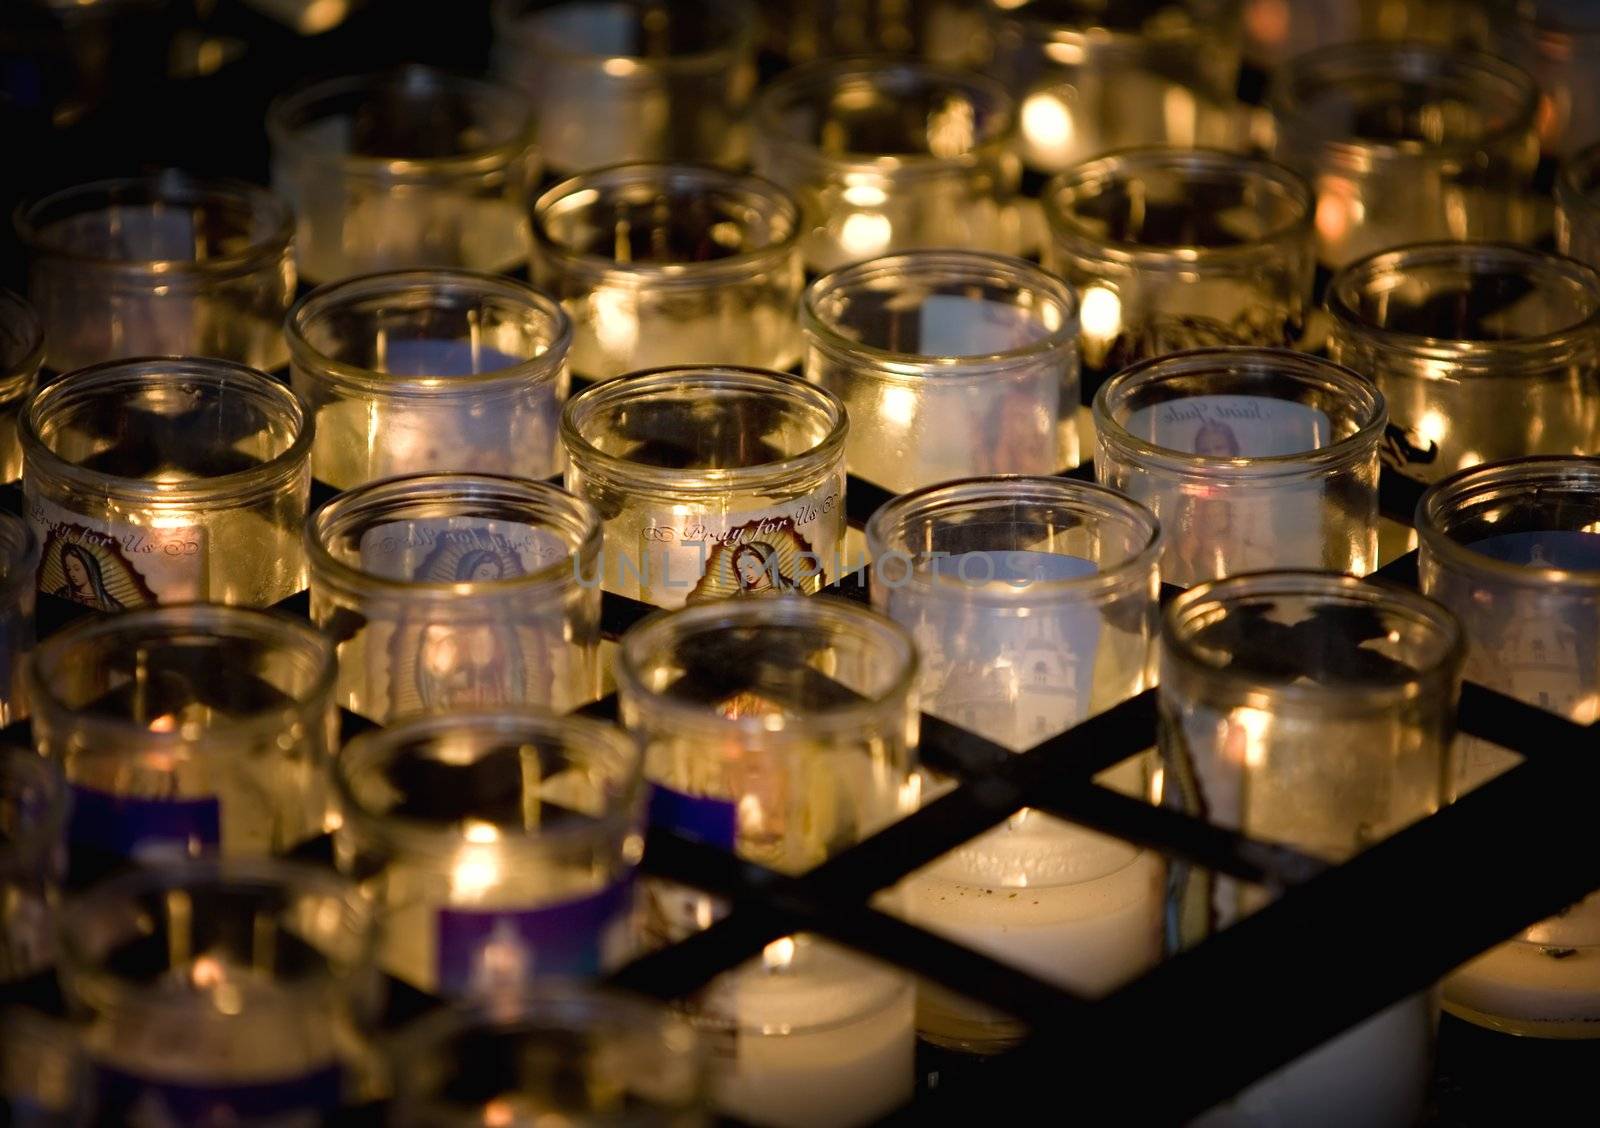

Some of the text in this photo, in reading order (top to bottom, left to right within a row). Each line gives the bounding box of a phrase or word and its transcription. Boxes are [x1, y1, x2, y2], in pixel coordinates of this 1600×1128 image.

[78, 527, 114, 546] for
[122, 534, 154, 554] Us
[683, 504, 818, 548] Pray for Us
